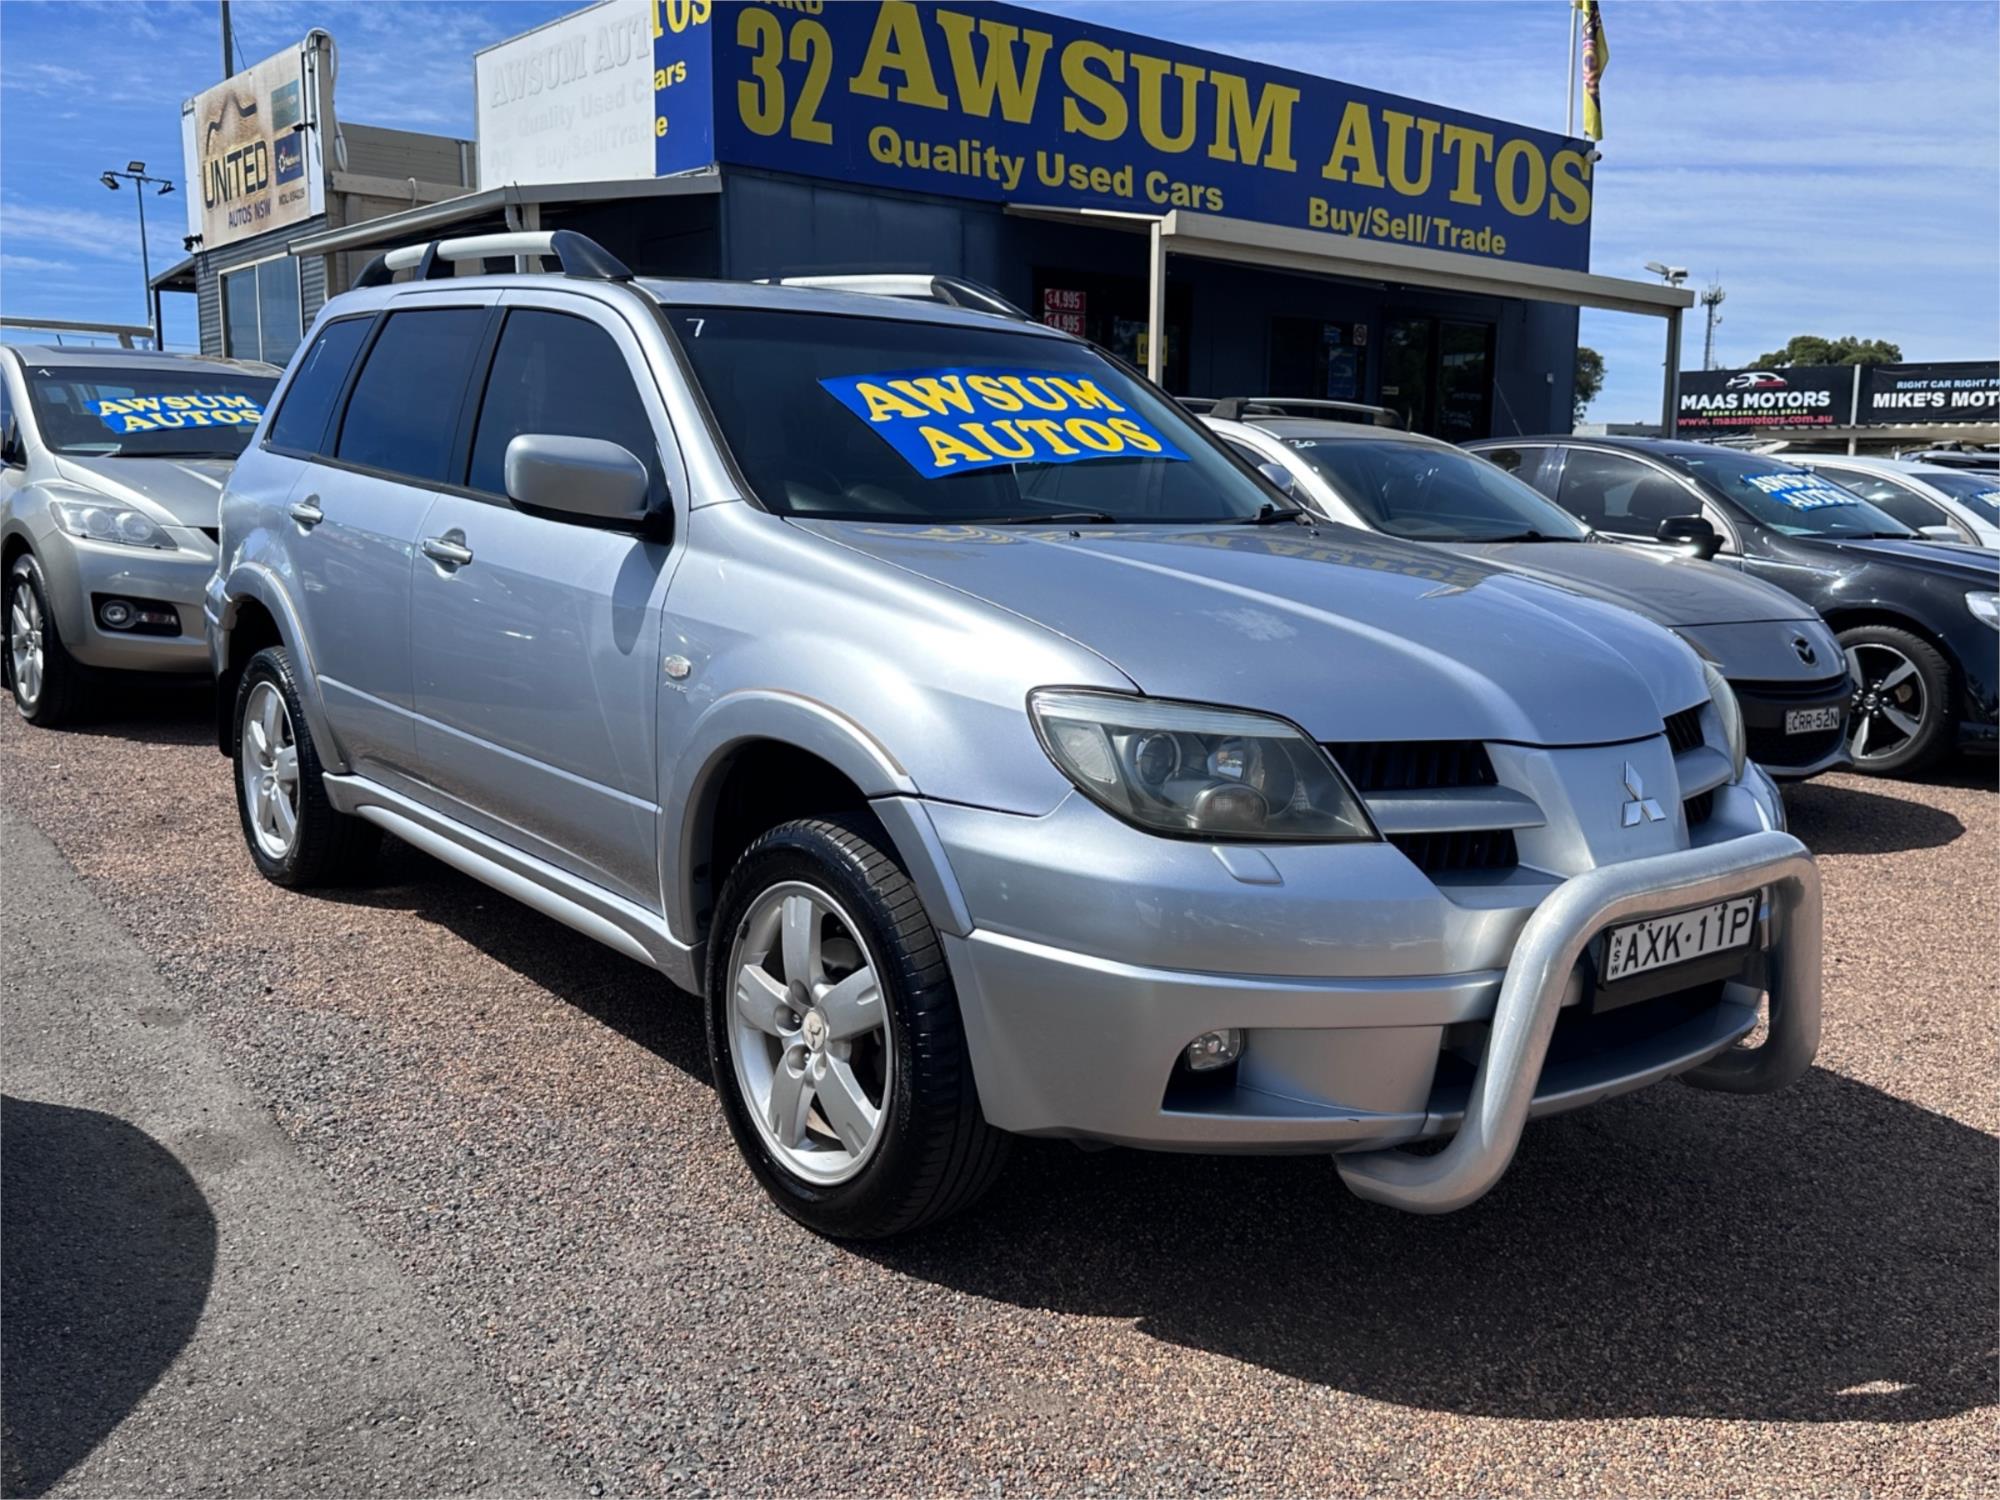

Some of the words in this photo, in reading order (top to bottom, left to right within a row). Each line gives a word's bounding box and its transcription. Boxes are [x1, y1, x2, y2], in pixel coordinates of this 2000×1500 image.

[737, 7, 833, 145] 32
[850, 1, 1300, 173] AWSUM
[1322, 101, 1591, 225] AUTOS
[203, 140, 269, 209] UNITED
[868, 126, 1025, 191] Quality
[1036, 151, 1133, 198] Used
[1145, 171, 1224, 212] Cars
[1308, 197, 1506, 255] Buy/Sell/Trade
[686, 318, 705, 338] 7
[98, 394, 257, 416] AWSUM
[856, 375, 1126, 422] AWSUM
[1680, 393, 1738, 410] MAAS
[1743, 391, 1831, 408] MOTORS
[1873, 392, 1945, 408] MIKE'S
[1951, 391, 1999, 407] MOT
[1896, 381, 1928, 389] RIGHT
[1954, 380, 1987, 388] RIGHT
[124, 409, 263, 431] AUTOS
[919, 417, 1163, 467] AUTOS
